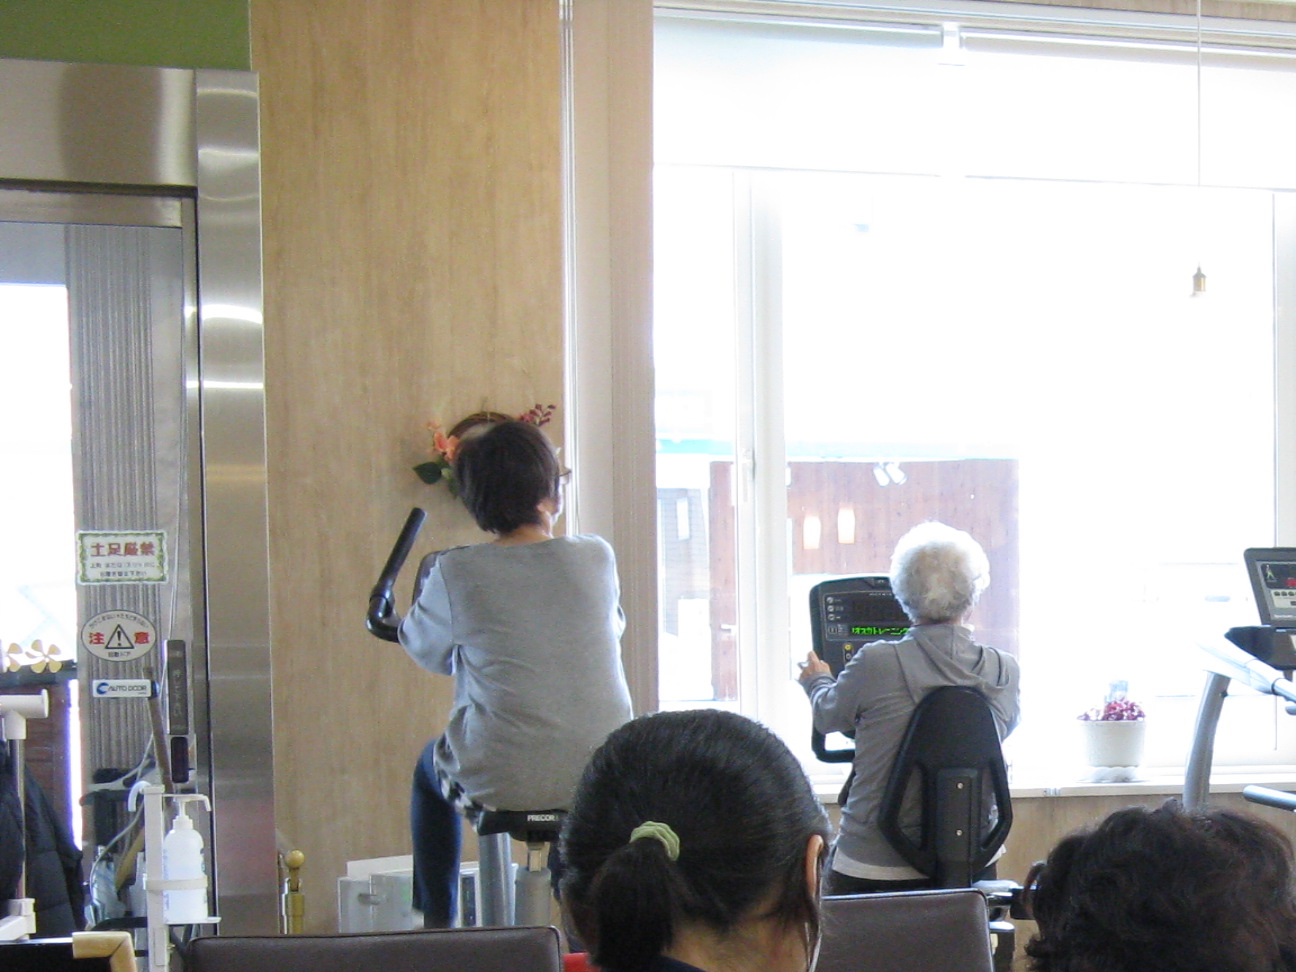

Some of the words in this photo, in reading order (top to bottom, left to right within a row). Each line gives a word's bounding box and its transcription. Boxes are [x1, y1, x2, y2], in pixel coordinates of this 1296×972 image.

[88, 631, 105, 645] 注
[134, 631, 150, 645] 意
[527, 814, 556, 822] PRECOR
